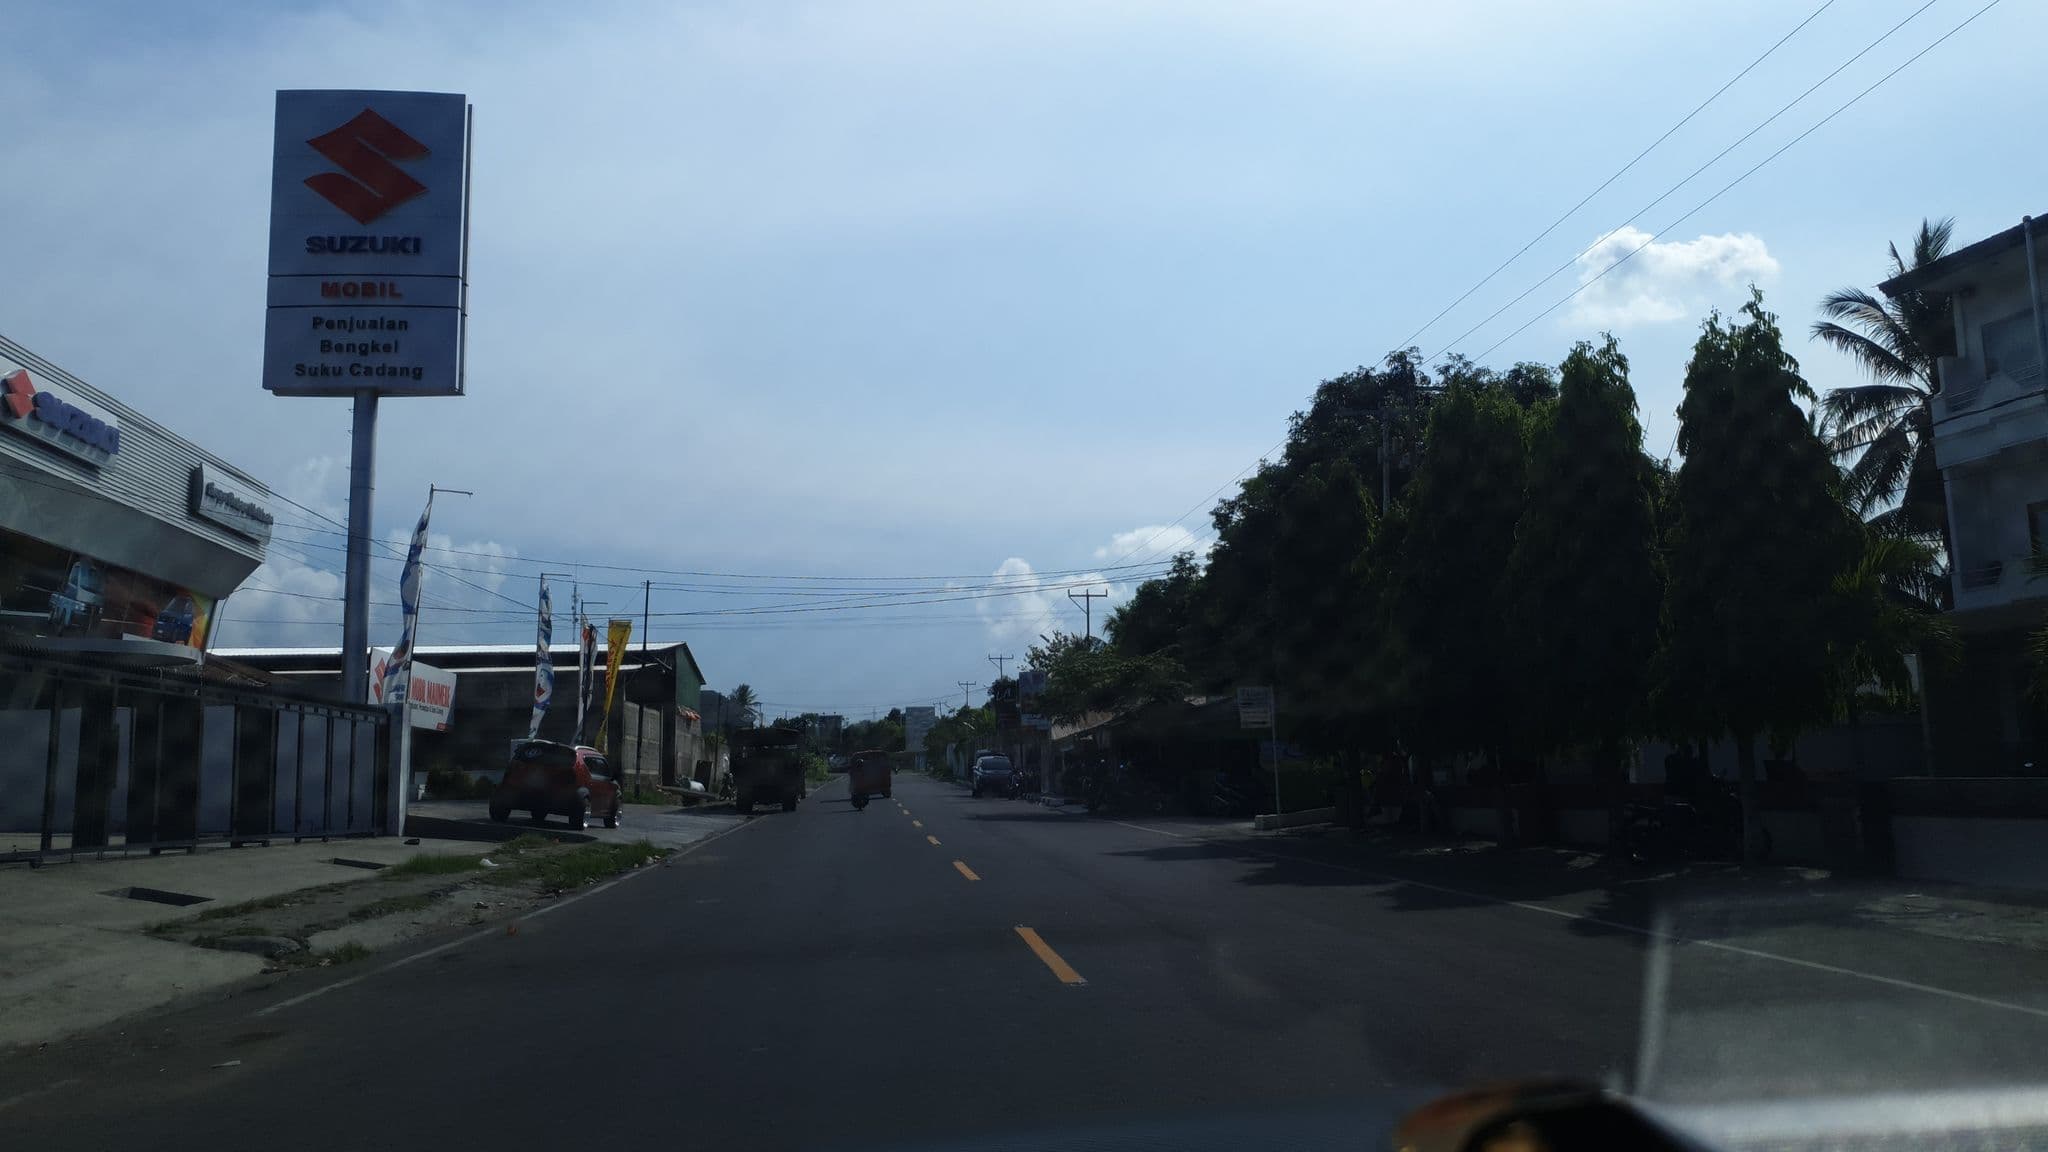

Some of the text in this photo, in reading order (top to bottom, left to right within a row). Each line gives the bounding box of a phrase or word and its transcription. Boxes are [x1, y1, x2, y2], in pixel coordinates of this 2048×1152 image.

[306, 235, 421, 254] SUZUKI
[321, 282, 402, 298] MOBIL
[312, 316, 409, 333] Penjualan
[320, 339, 398, 356] Bengkel
[295, 363, 423, 380] Suku Cadang
